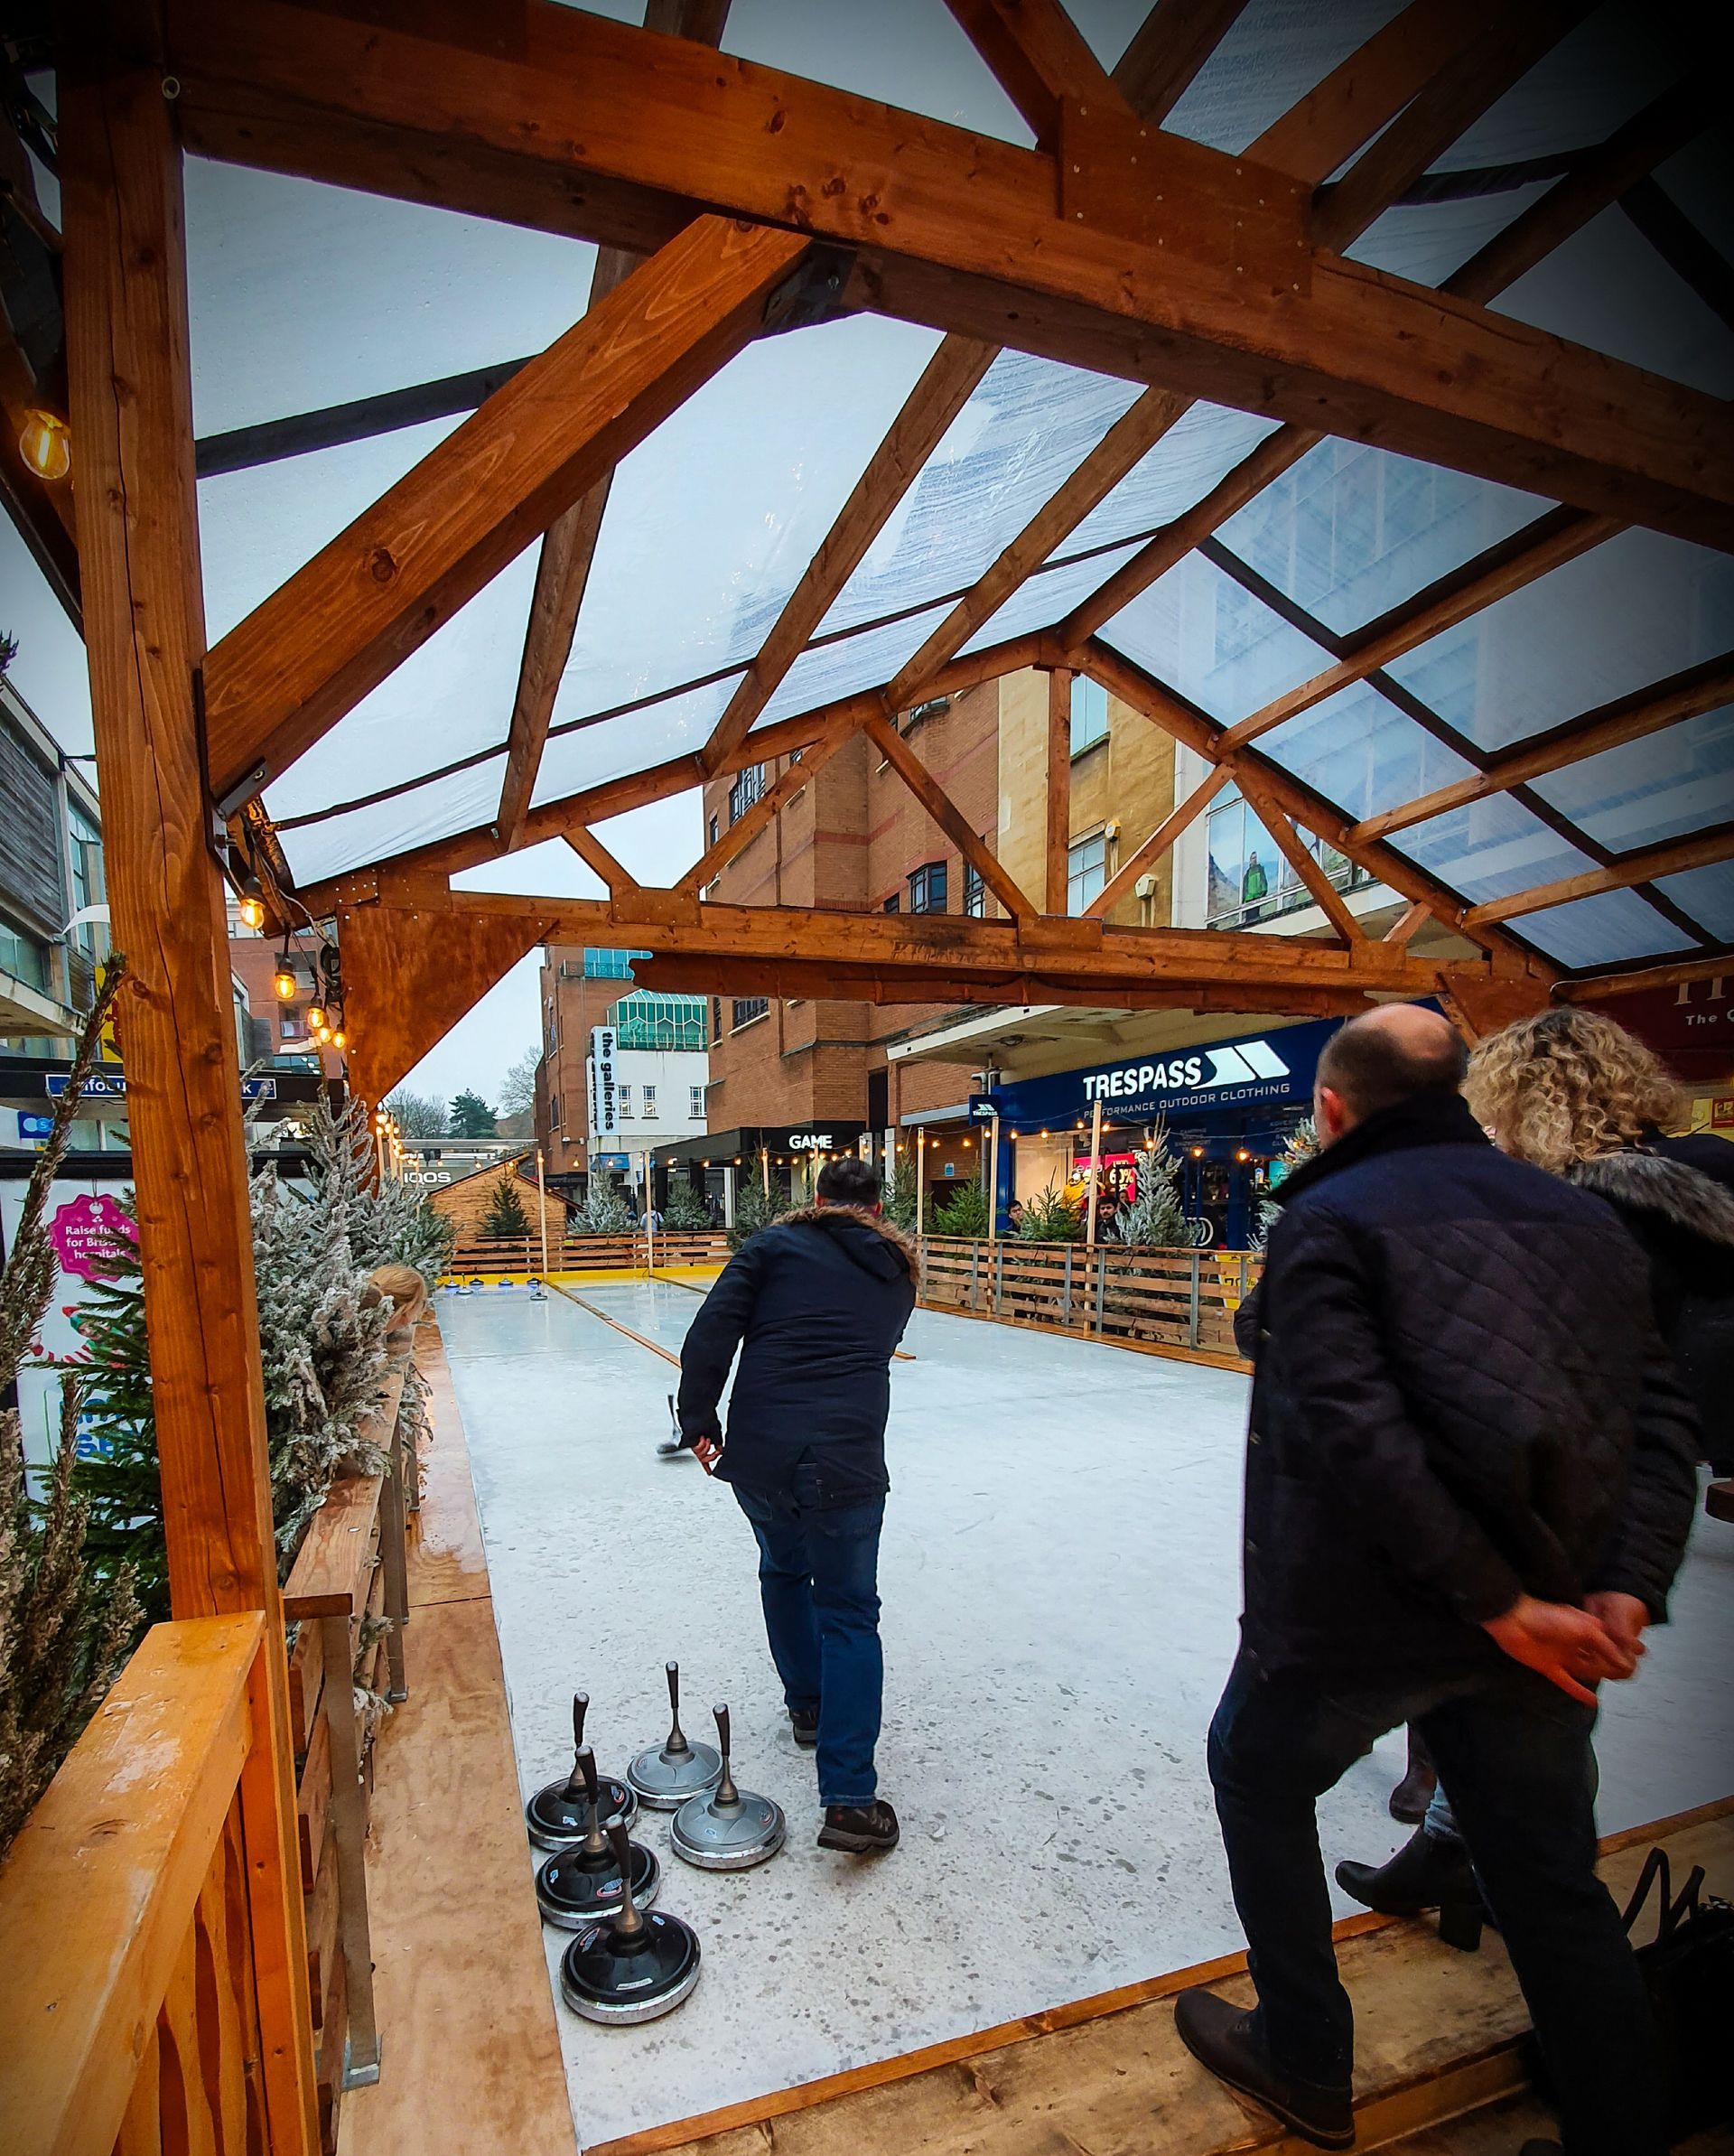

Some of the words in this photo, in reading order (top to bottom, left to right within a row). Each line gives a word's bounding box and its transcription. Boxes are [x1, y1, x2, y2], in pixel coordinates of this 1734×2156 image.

[1685, 1013, 1719, 1026] The
[602, 1031, 613, 1058] the
[1083, 1057, 1202, 1101] TRESPASS
[600, 1062, 616, 1131] galleries
[1083, 1101, 1156, 1119] PEFORMANCE
[1159, 1093, 1217, 1110] OUTDOOR
[1220, 1083, 1291, 1101] CLOTHING
[788, 1134, 833, 1150] GAME
[404, 1171, 452, 1185] IQOS
[65, 1226, 96, 1235] Raise
[66, 1237, 84, 1246] for
